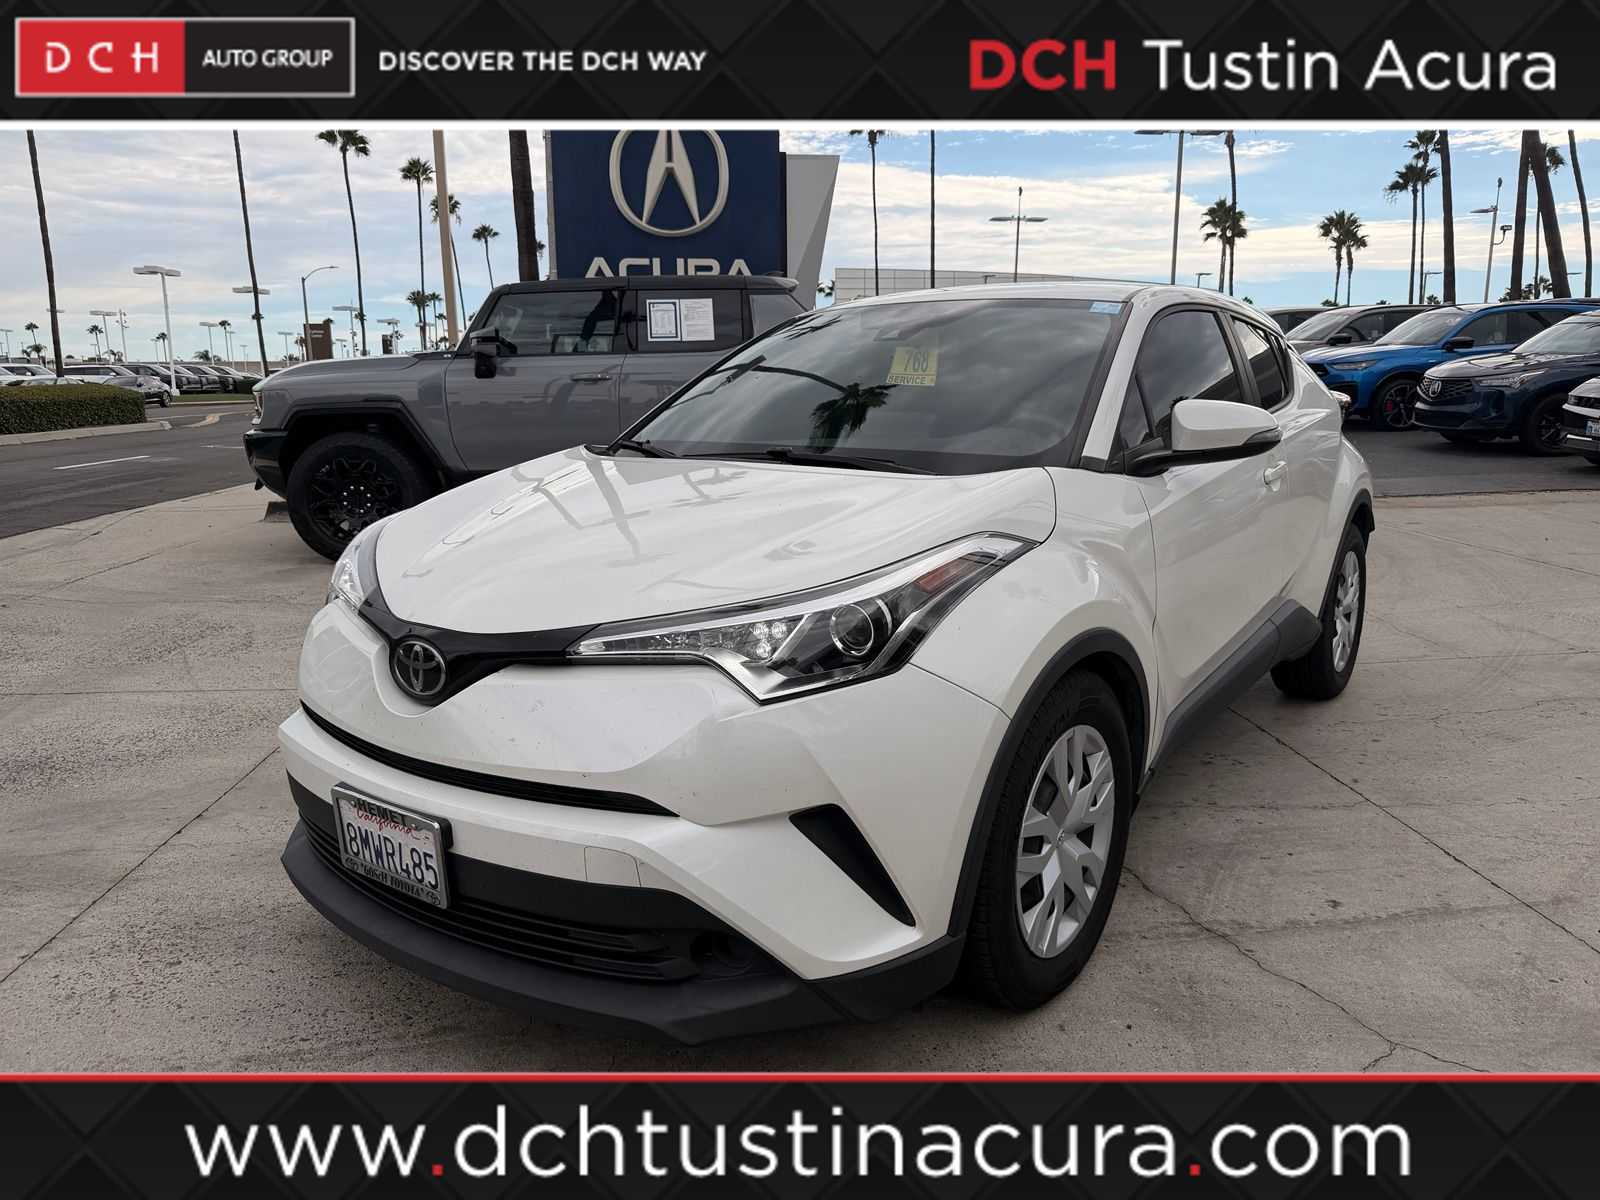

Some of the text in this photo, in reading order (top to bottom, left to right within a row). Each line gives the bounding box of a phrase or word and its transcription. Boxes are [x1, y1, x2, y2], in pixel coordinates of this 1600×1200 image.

[904, 349, 929, 373] 768
[887, 375, 927, 385] SERVICE
[346, 821, 439, 890] 8MWR485
